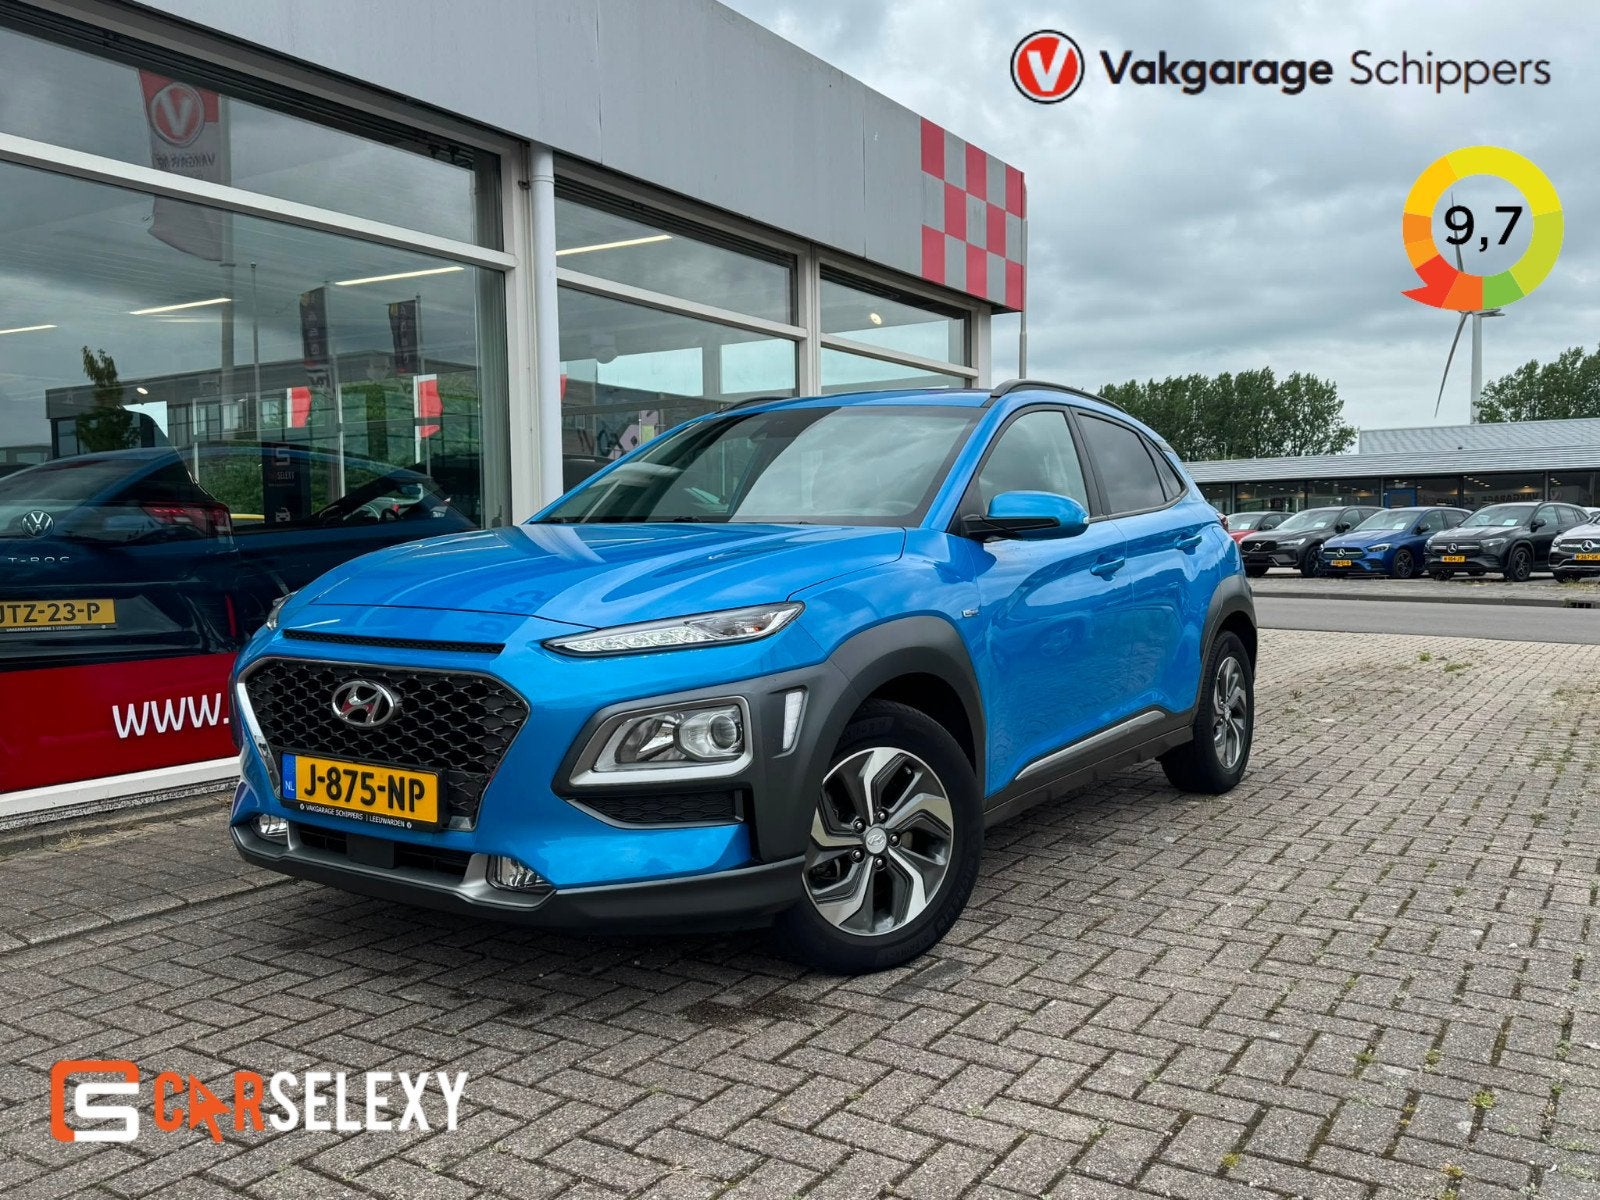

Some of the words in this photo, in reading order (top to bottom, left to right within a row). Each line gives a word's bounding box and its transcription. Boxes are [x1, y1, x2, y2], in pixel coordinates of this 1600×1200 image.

[284, 780, 295, 791] NL
[304, 763, 426, 813] J-875-NP
[306, 804, 335, 816] VAKGARAGE
[335, 809, 364, 820] SCHIPPERS
[369, 815, 406, 828] LEEUWARDEN
